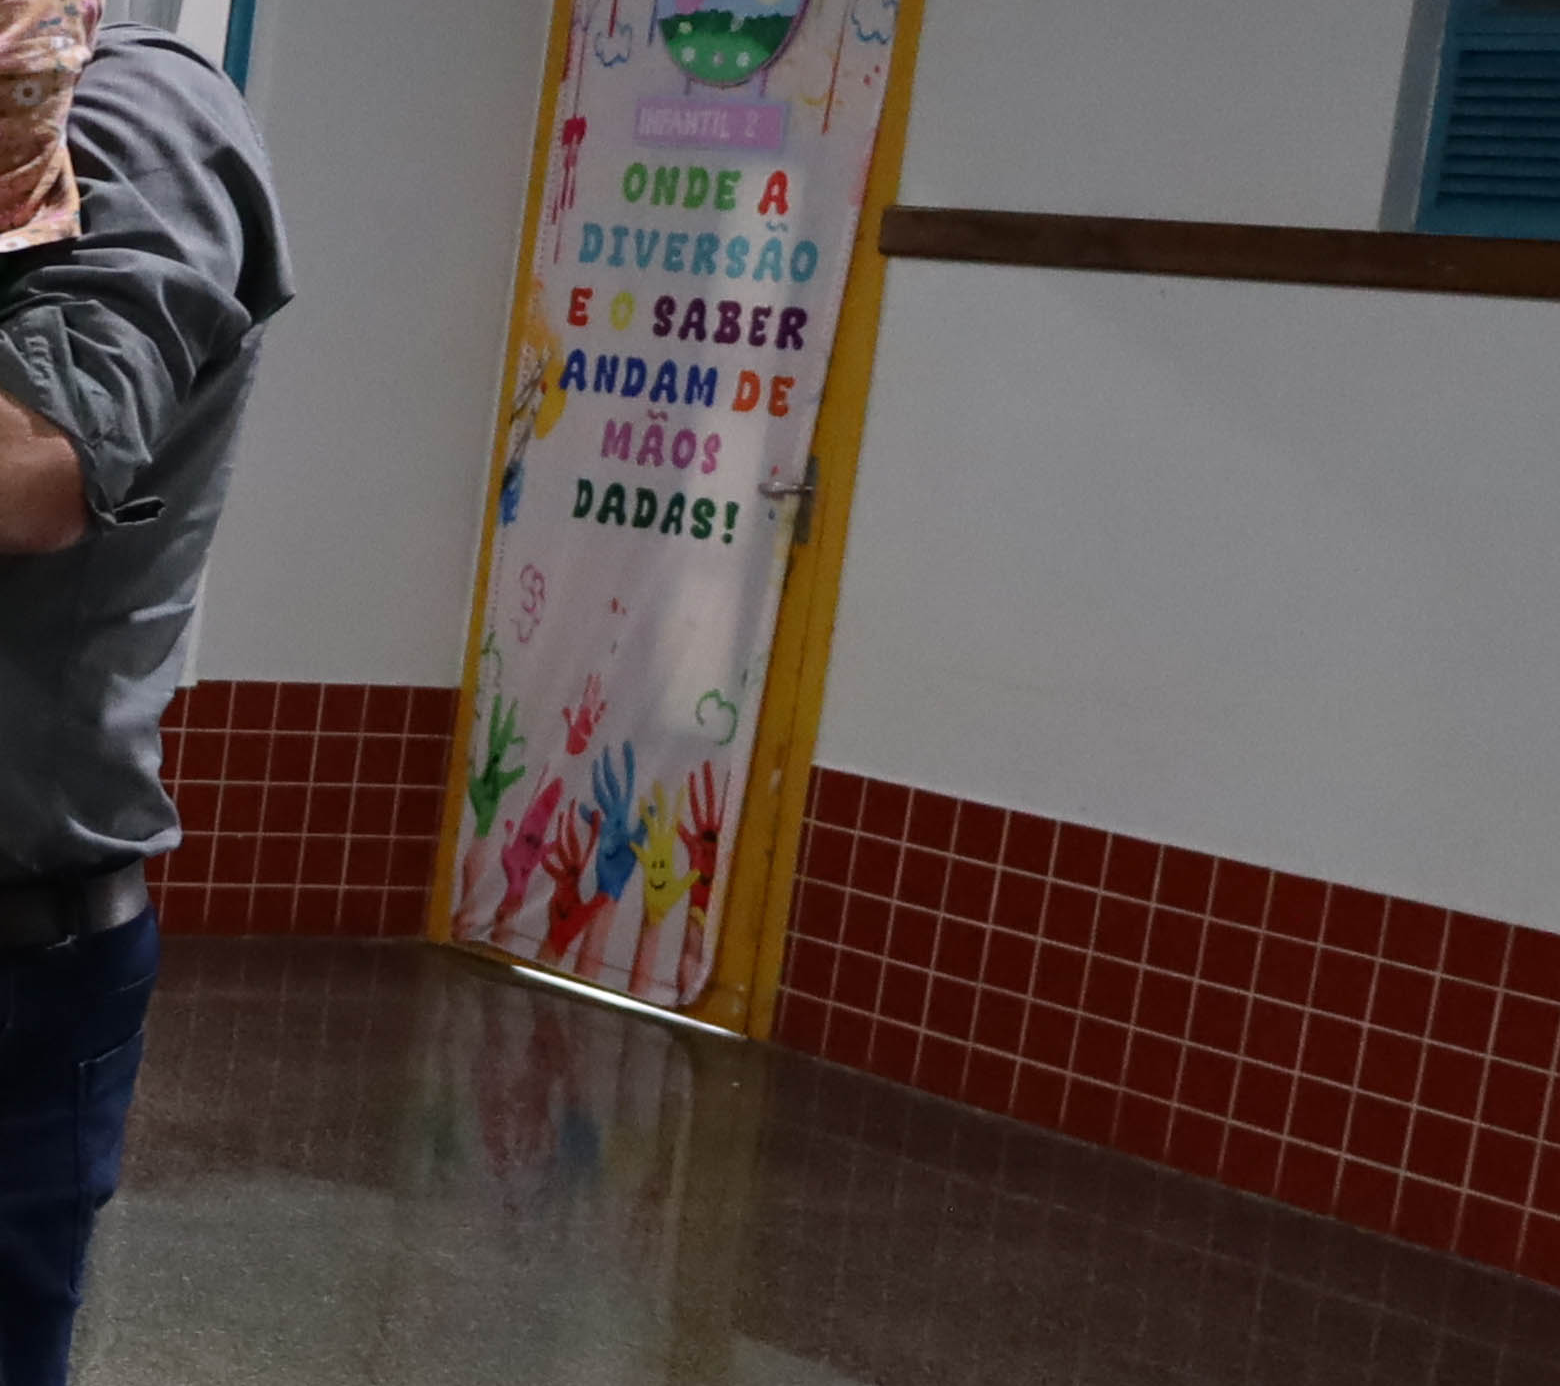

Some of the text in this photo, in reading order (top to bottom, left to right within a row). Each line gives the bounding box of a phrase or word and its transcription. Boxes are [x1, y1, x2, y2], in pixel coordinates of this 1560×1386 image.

[623, 162, 789, 216] ONDE A
[578, 220, 819, 284] DIVERSÃO
[567, 286, 808, 350] E O SABER
[558, 348, 796, 417] ANDAM DE
[600, 409, 722, 475] MÃOS
[572, 478, 740, 545] DADAS!
